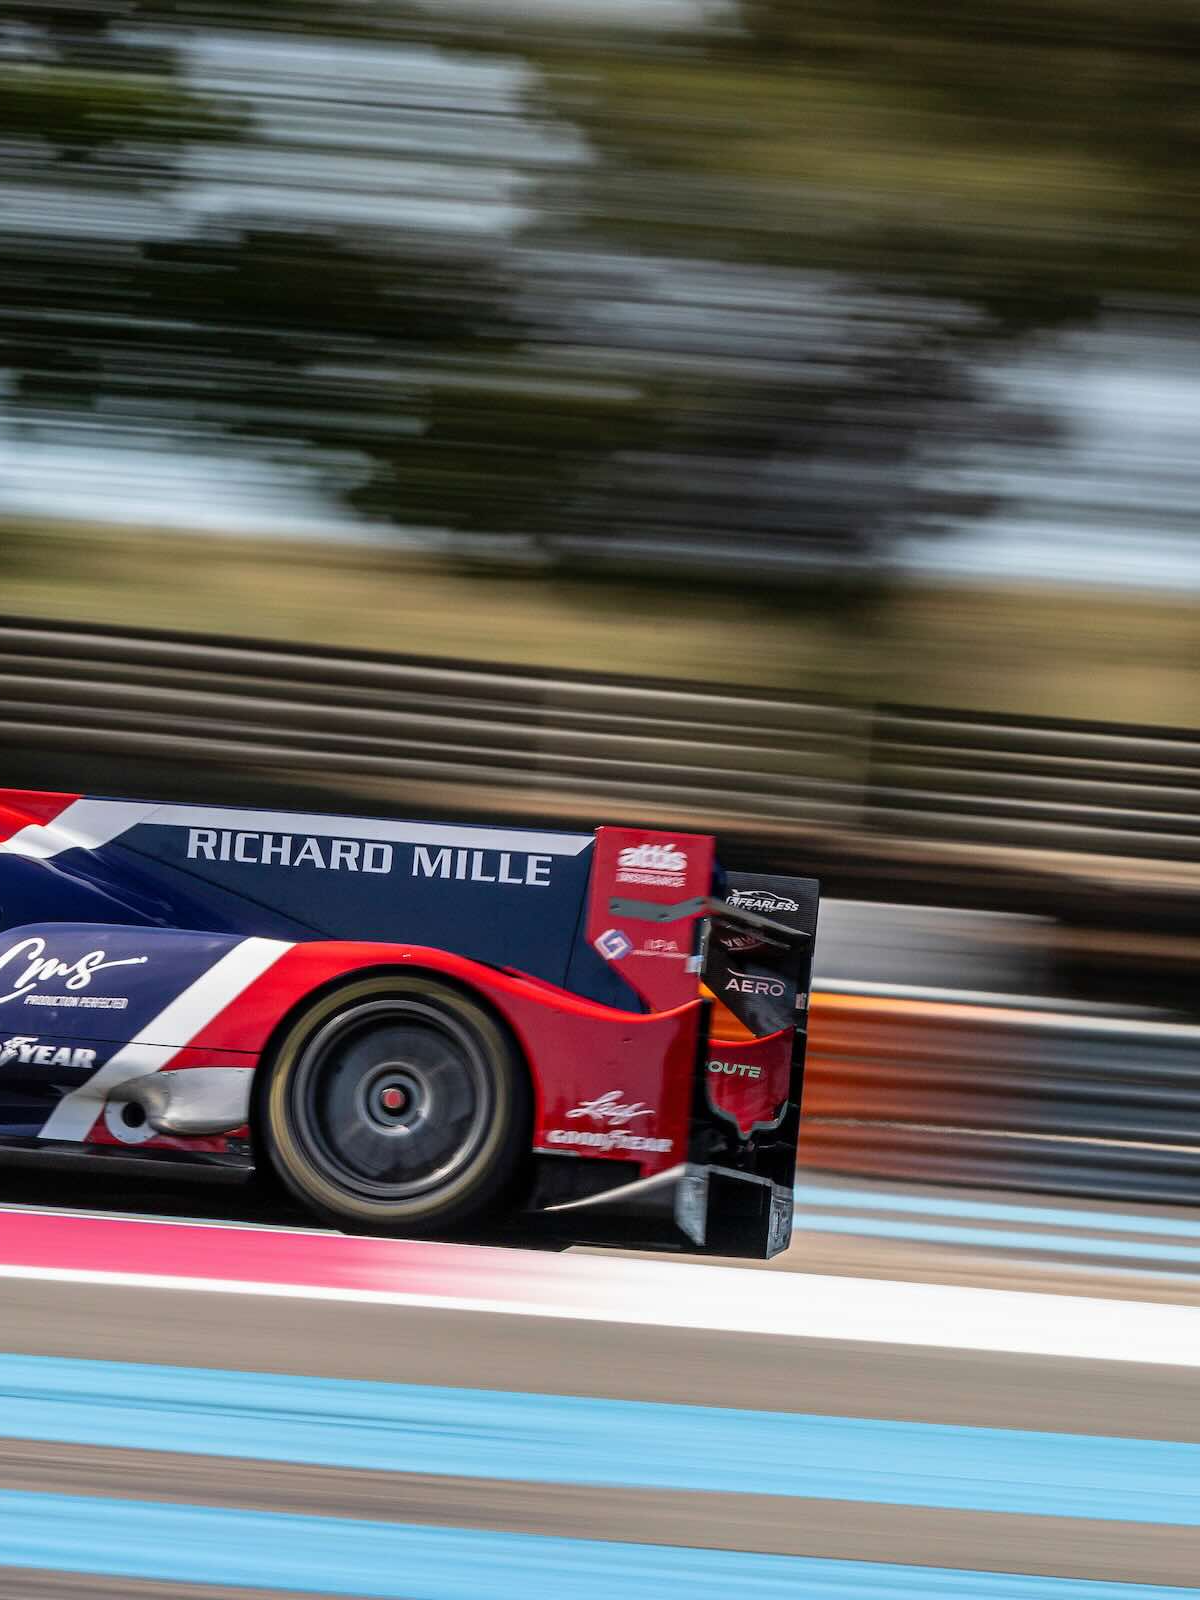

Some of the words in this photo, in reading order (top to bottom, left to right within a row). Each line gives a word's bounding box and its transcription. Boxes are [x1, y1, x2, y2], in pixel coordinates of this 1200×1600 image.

[186, 828, 393, 874] RICHARD
[412, 846, 553, 887] MILLE
[737, 898, 800, 913] FEARLESS
[725, 978, 785, 997] AERO
